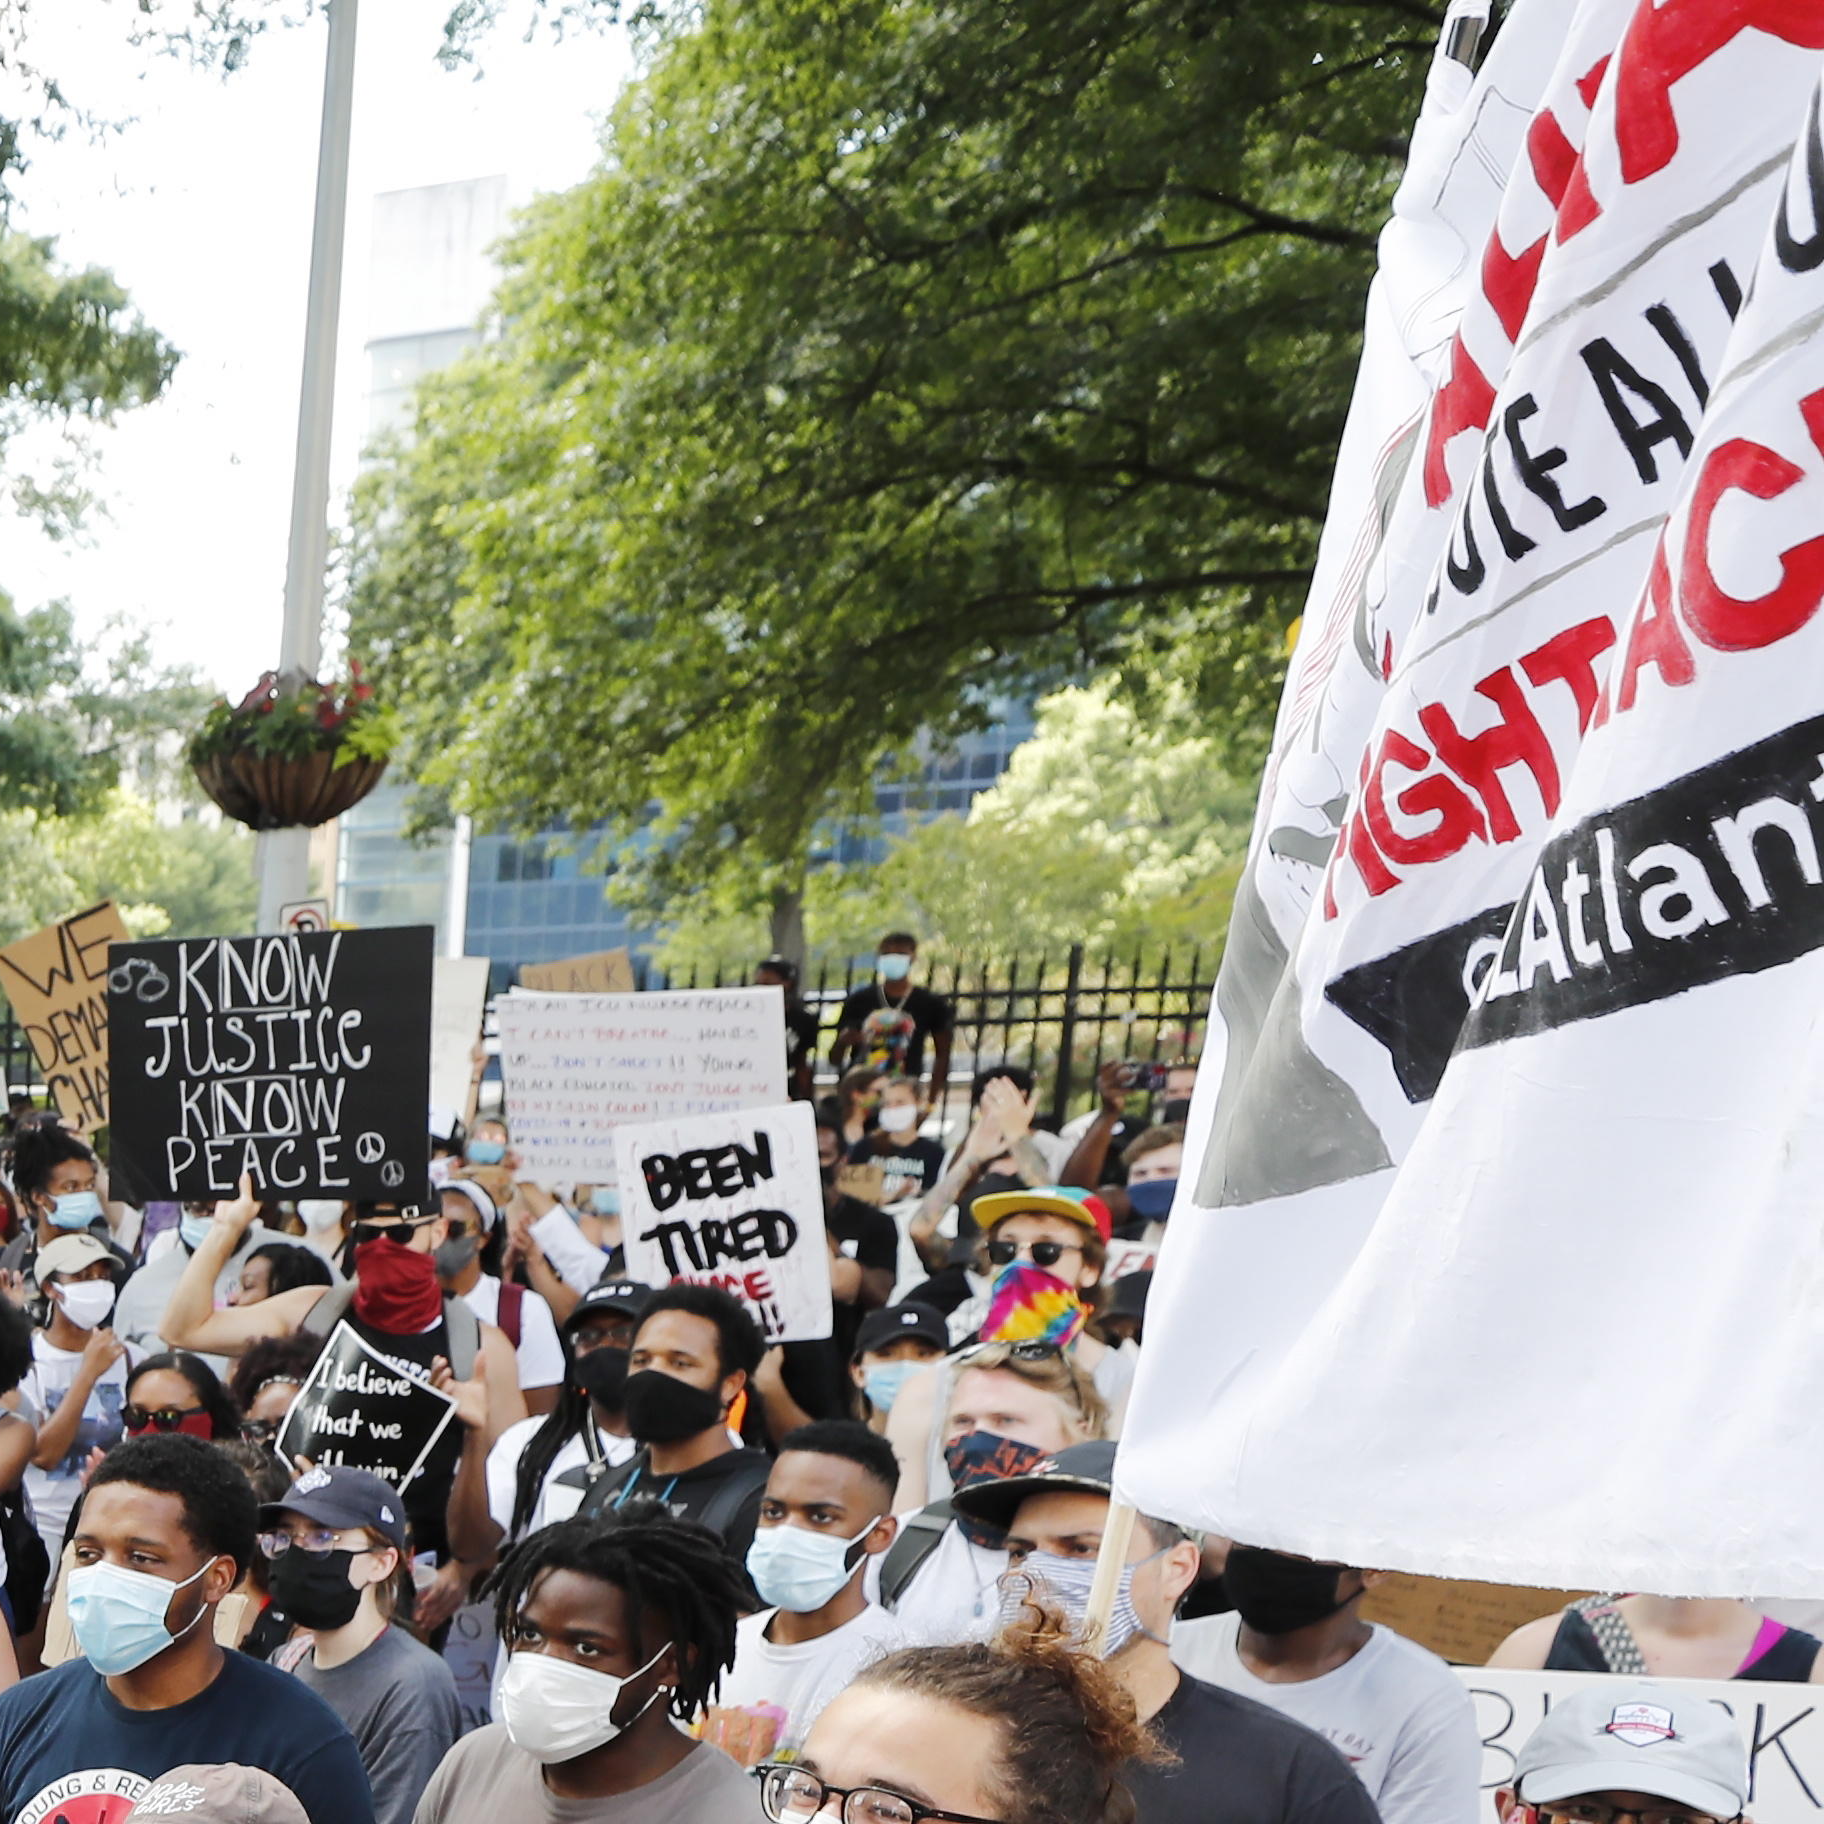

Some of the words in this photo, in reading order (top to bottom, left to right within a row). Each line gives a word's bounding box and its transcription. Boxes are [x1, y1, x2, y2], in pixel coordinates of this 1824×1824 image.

[0, 901, 113, 997] WE
[178, 932, 343, 1014] KNOW
[24, 991, 109, 1071] DEMA
[180, 1077, 346, 1138] KNOW
[167, 1135, 350, 1191] PEACE
[642, 1130, 775, 1212] BEEN
[640, 1208, 798, 1278] TIRED
[317, 1357, 333, 1389] I
[335, 1360, 412, 1397] believe
[311, 1404, 364, 1438] that
[369, 1422, 403, 1440] we
[316, 1449, 344, 1468] ill
[92, 1775, 106, 1791] &
